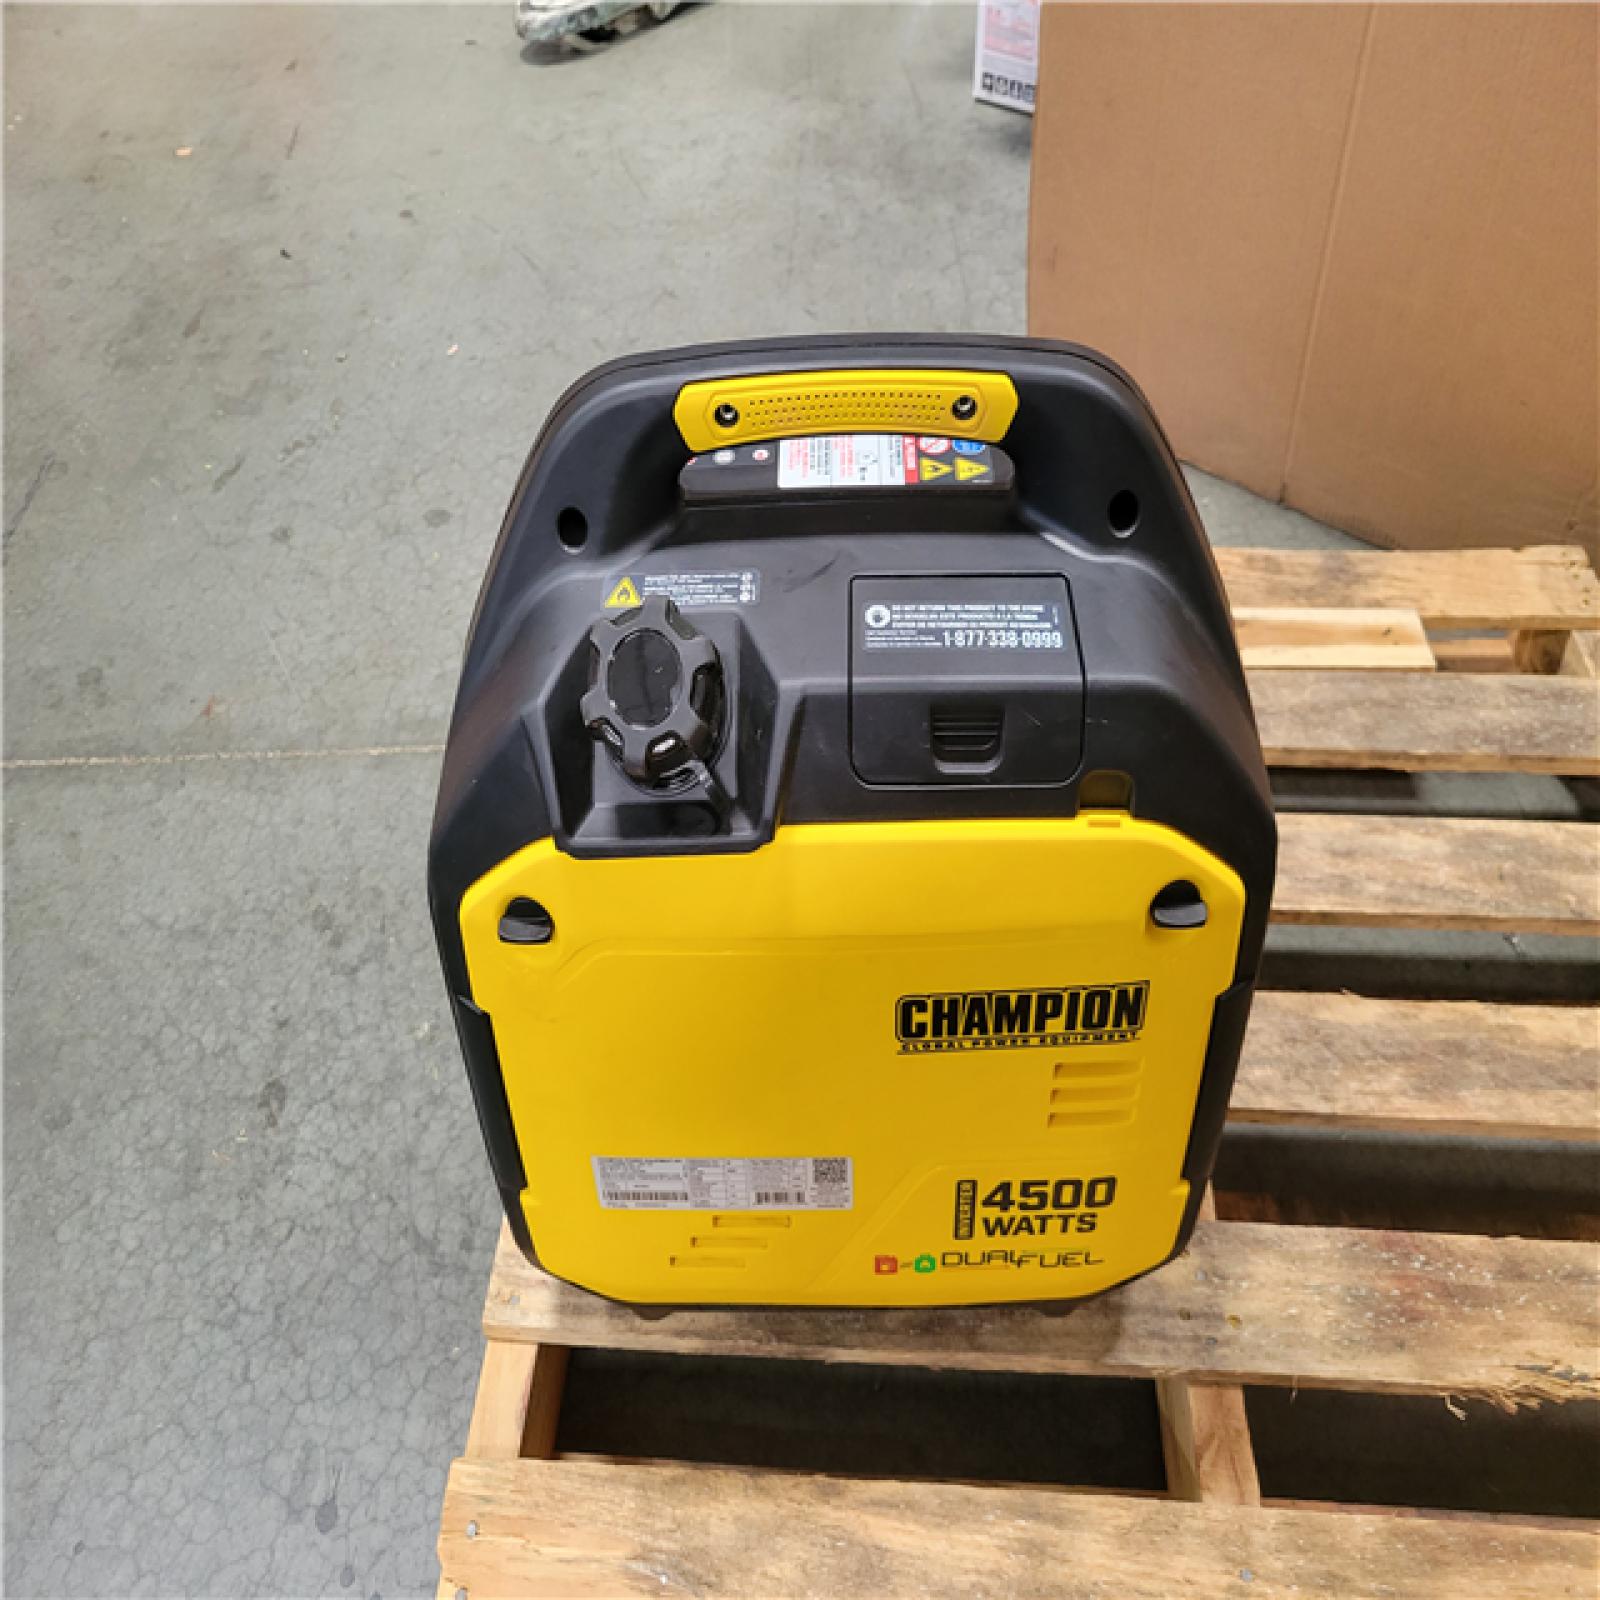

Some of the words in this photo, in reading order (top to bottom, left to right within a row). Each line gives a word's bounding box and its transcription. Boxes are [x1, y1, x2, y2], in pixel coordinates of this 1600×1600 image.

[901, 986, 1144, 1038] CHAMPION
[981, 1176, 1117, 1212] 4500
[982, 1212, 1098, 1237] WATTS
